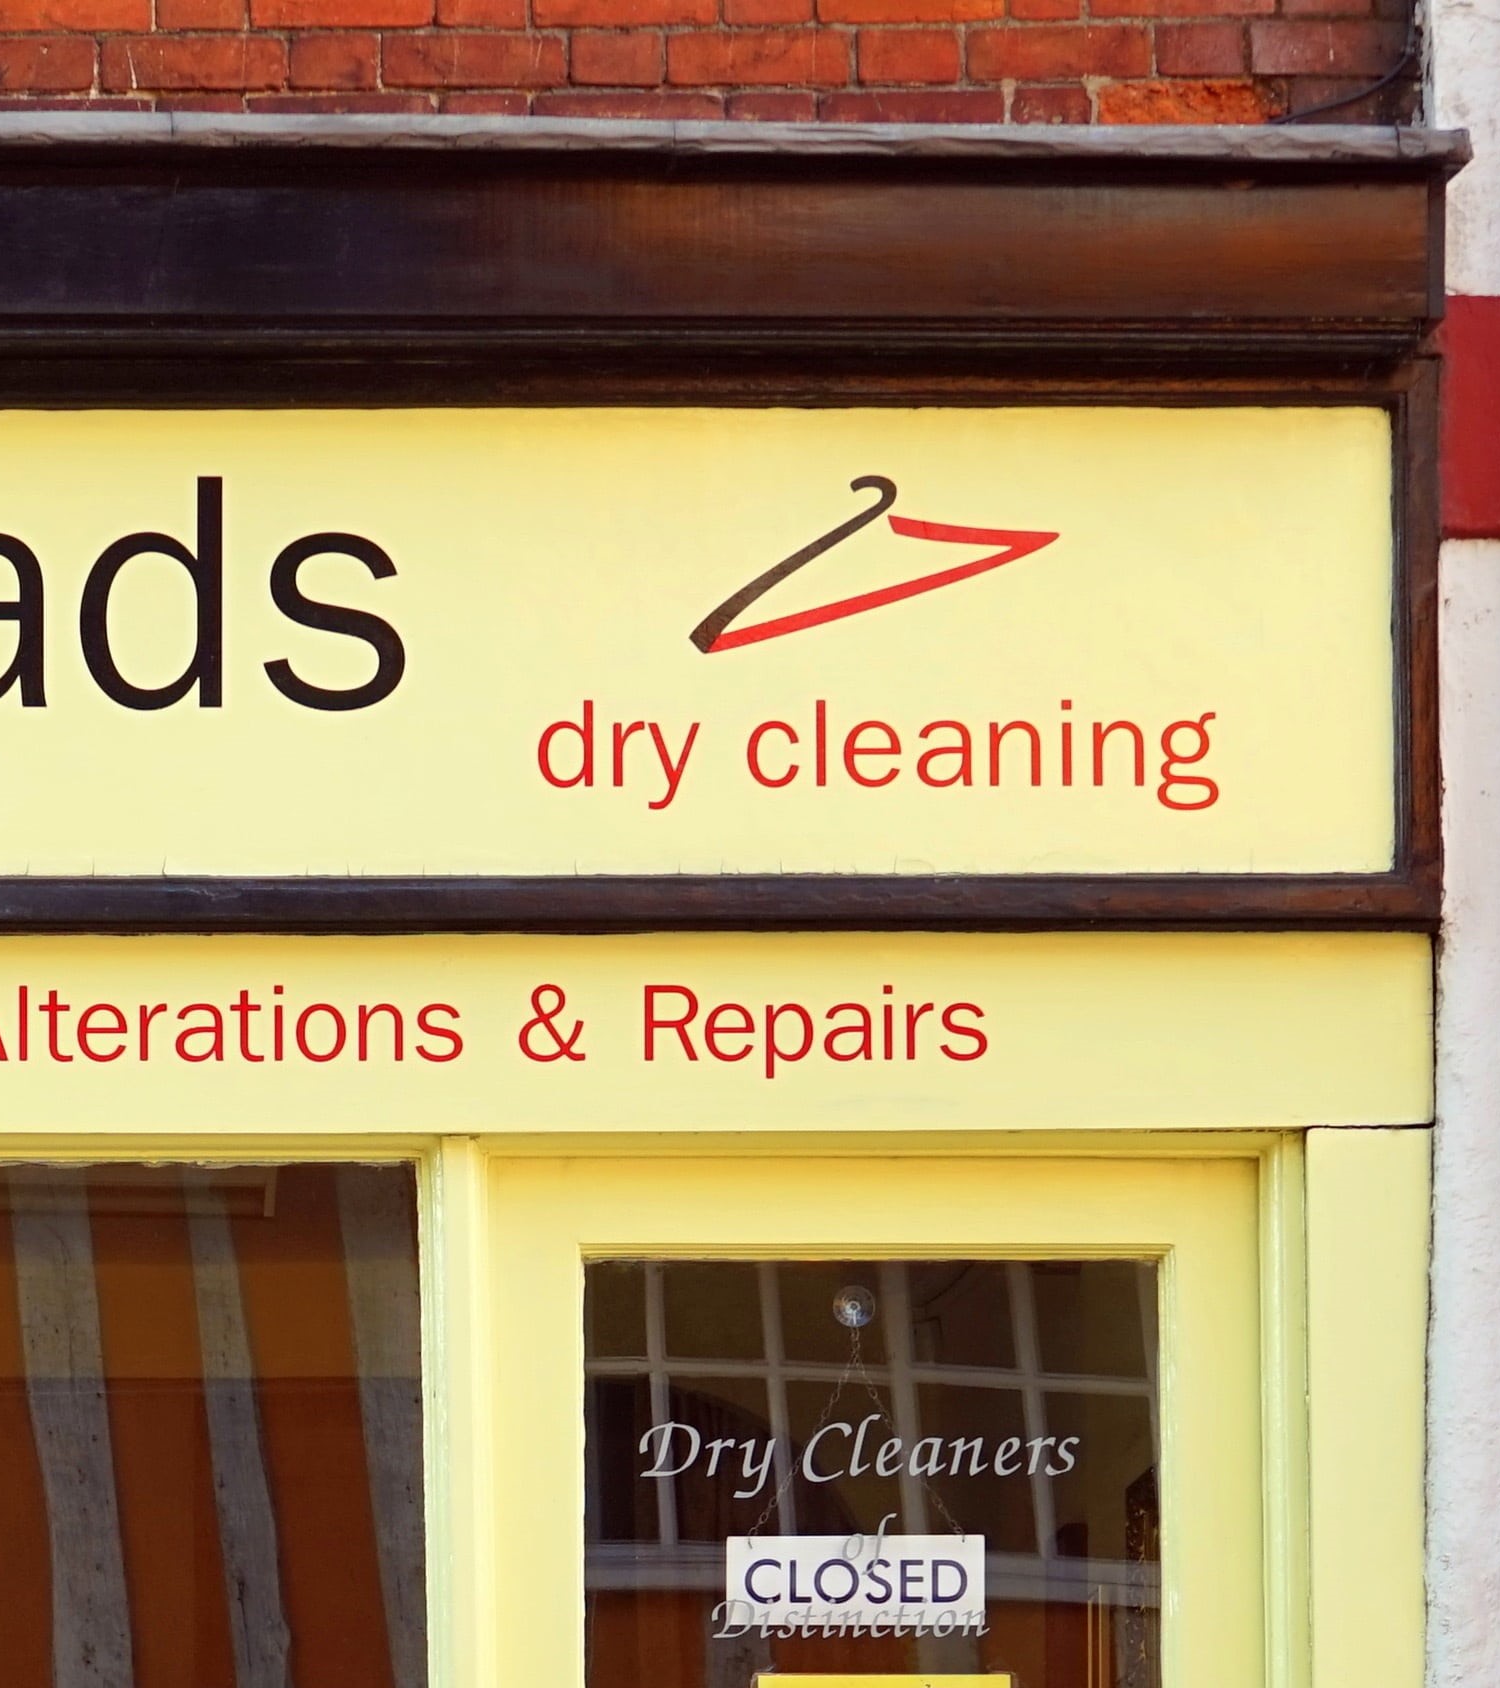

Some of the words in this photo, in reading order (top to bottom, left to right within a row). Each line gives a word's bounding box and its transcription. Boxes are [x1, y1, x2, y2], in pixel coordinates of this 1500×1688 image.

[538, 700, 701, 811] dry
[747, 700, 1220, 812] cleaning
[519, 984, 587, 1065] &
[645, 984, 990, 1081] Repairs
[639, 1420, 777, 1499] Dry
[802, 1414, 1080, 1483] Cleaners
[744, 1558, 969, 1605] CLOSED
[841, 1513, 900, 1576] of
[712, 1598, 991, 1641] Distinction
